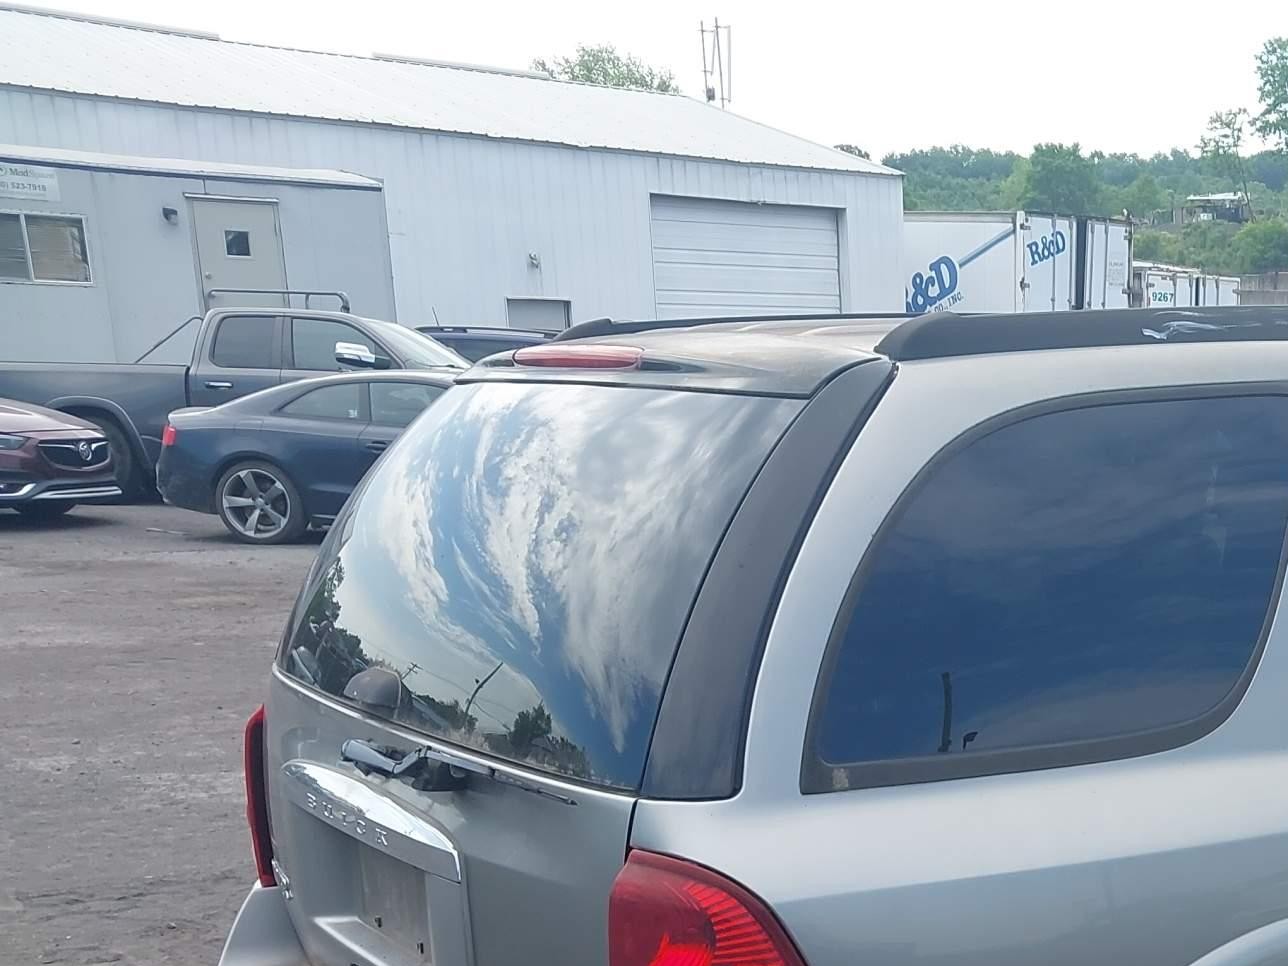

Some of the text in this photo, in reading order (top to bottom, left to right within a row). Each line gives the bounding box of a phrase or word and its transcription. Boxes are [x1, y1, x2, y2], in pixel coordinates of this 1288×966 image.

[1026, 230, 1066, 267] R&D
[1151, 291, 1175, 303] 9267
[306, 792, 388, 846] BUICK
